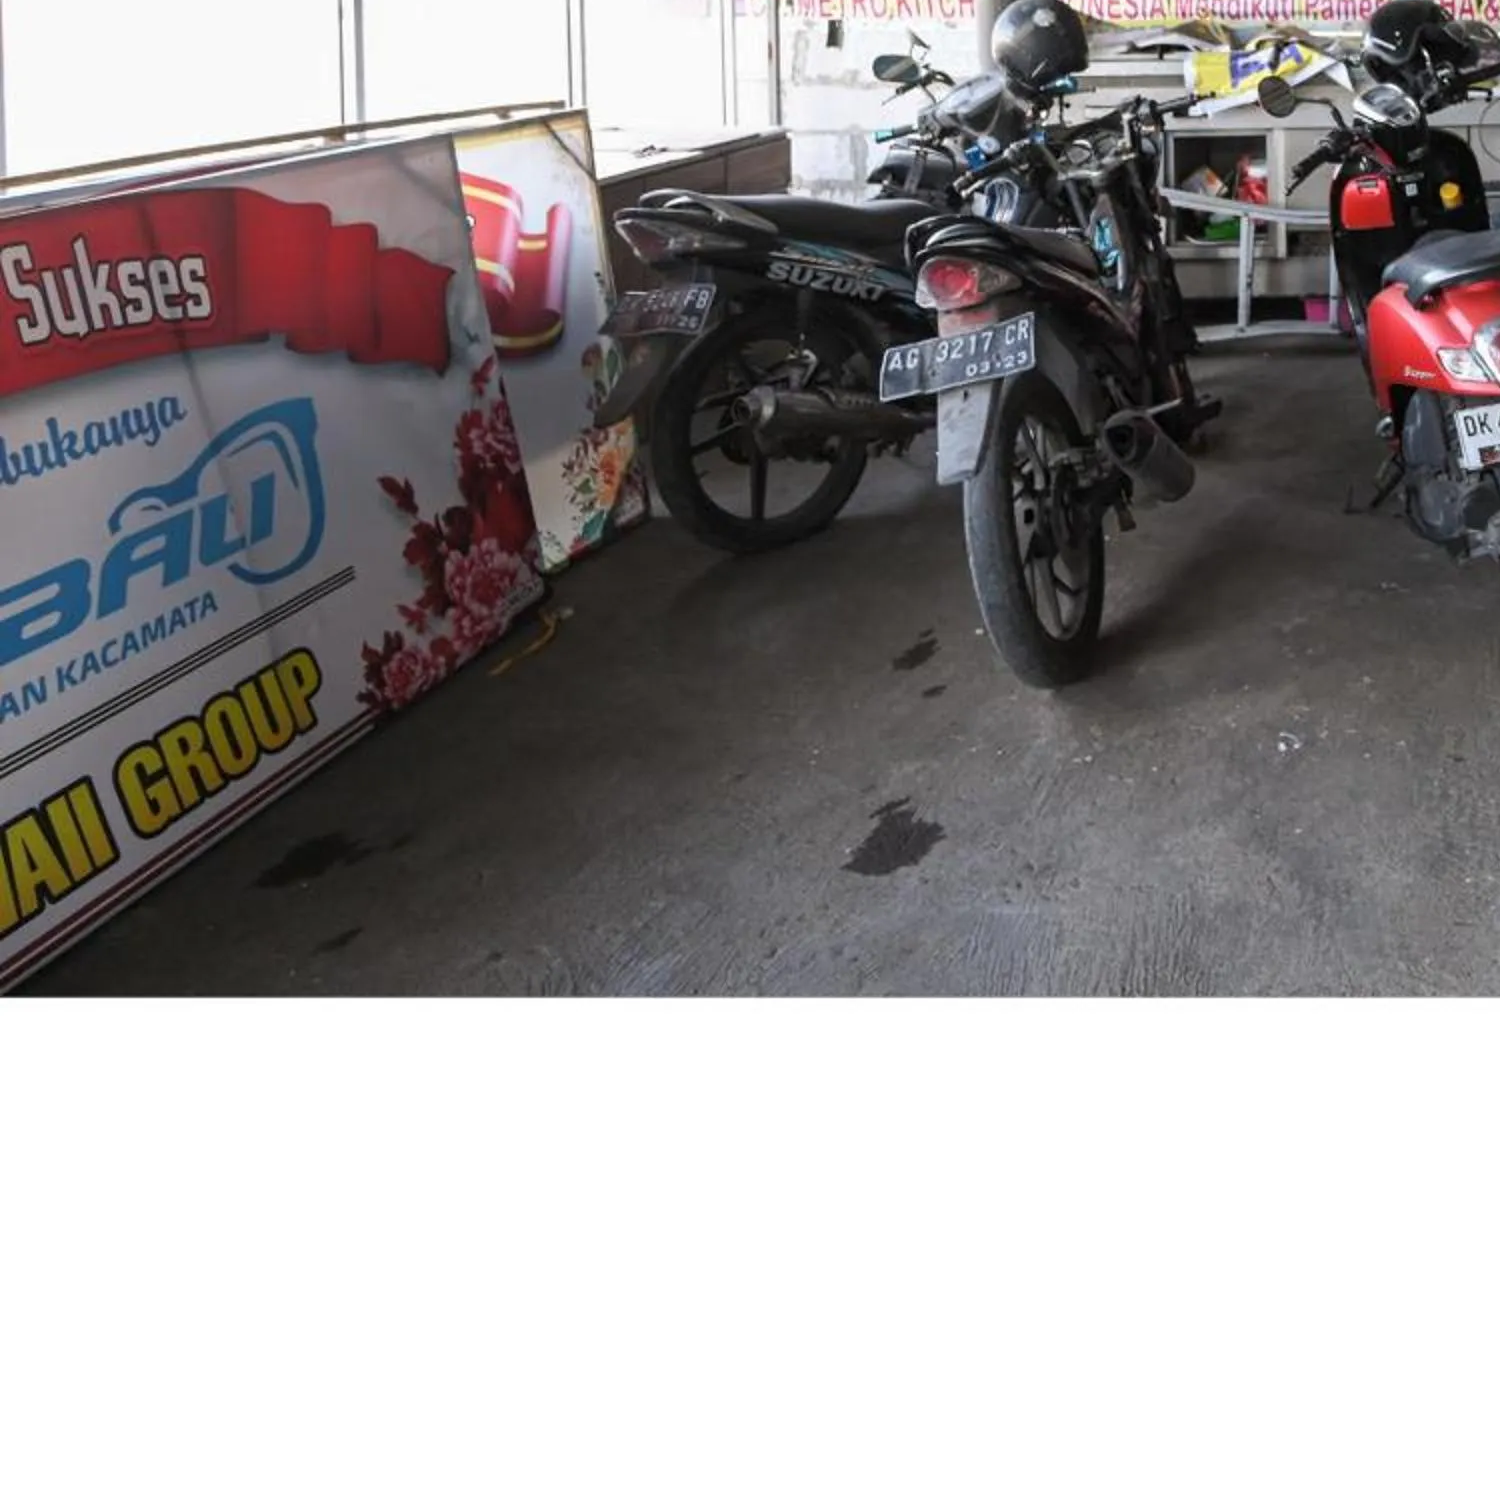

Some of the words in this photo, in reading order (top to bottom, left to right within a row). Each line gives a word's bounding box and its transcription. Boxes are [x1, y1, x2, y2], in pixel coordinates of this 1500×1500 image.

[2, 234, 213, 347] Sukses
[766, 259, 884, 301] SUZUKI
[1004, 318, 1030, 346] CR
[1463, 413, 1493, 437] DK
[56, 590, 219, 693] KACAMATA
[0, 775, 121, 940] AII
[114, 648, 322, 839] GROUP
